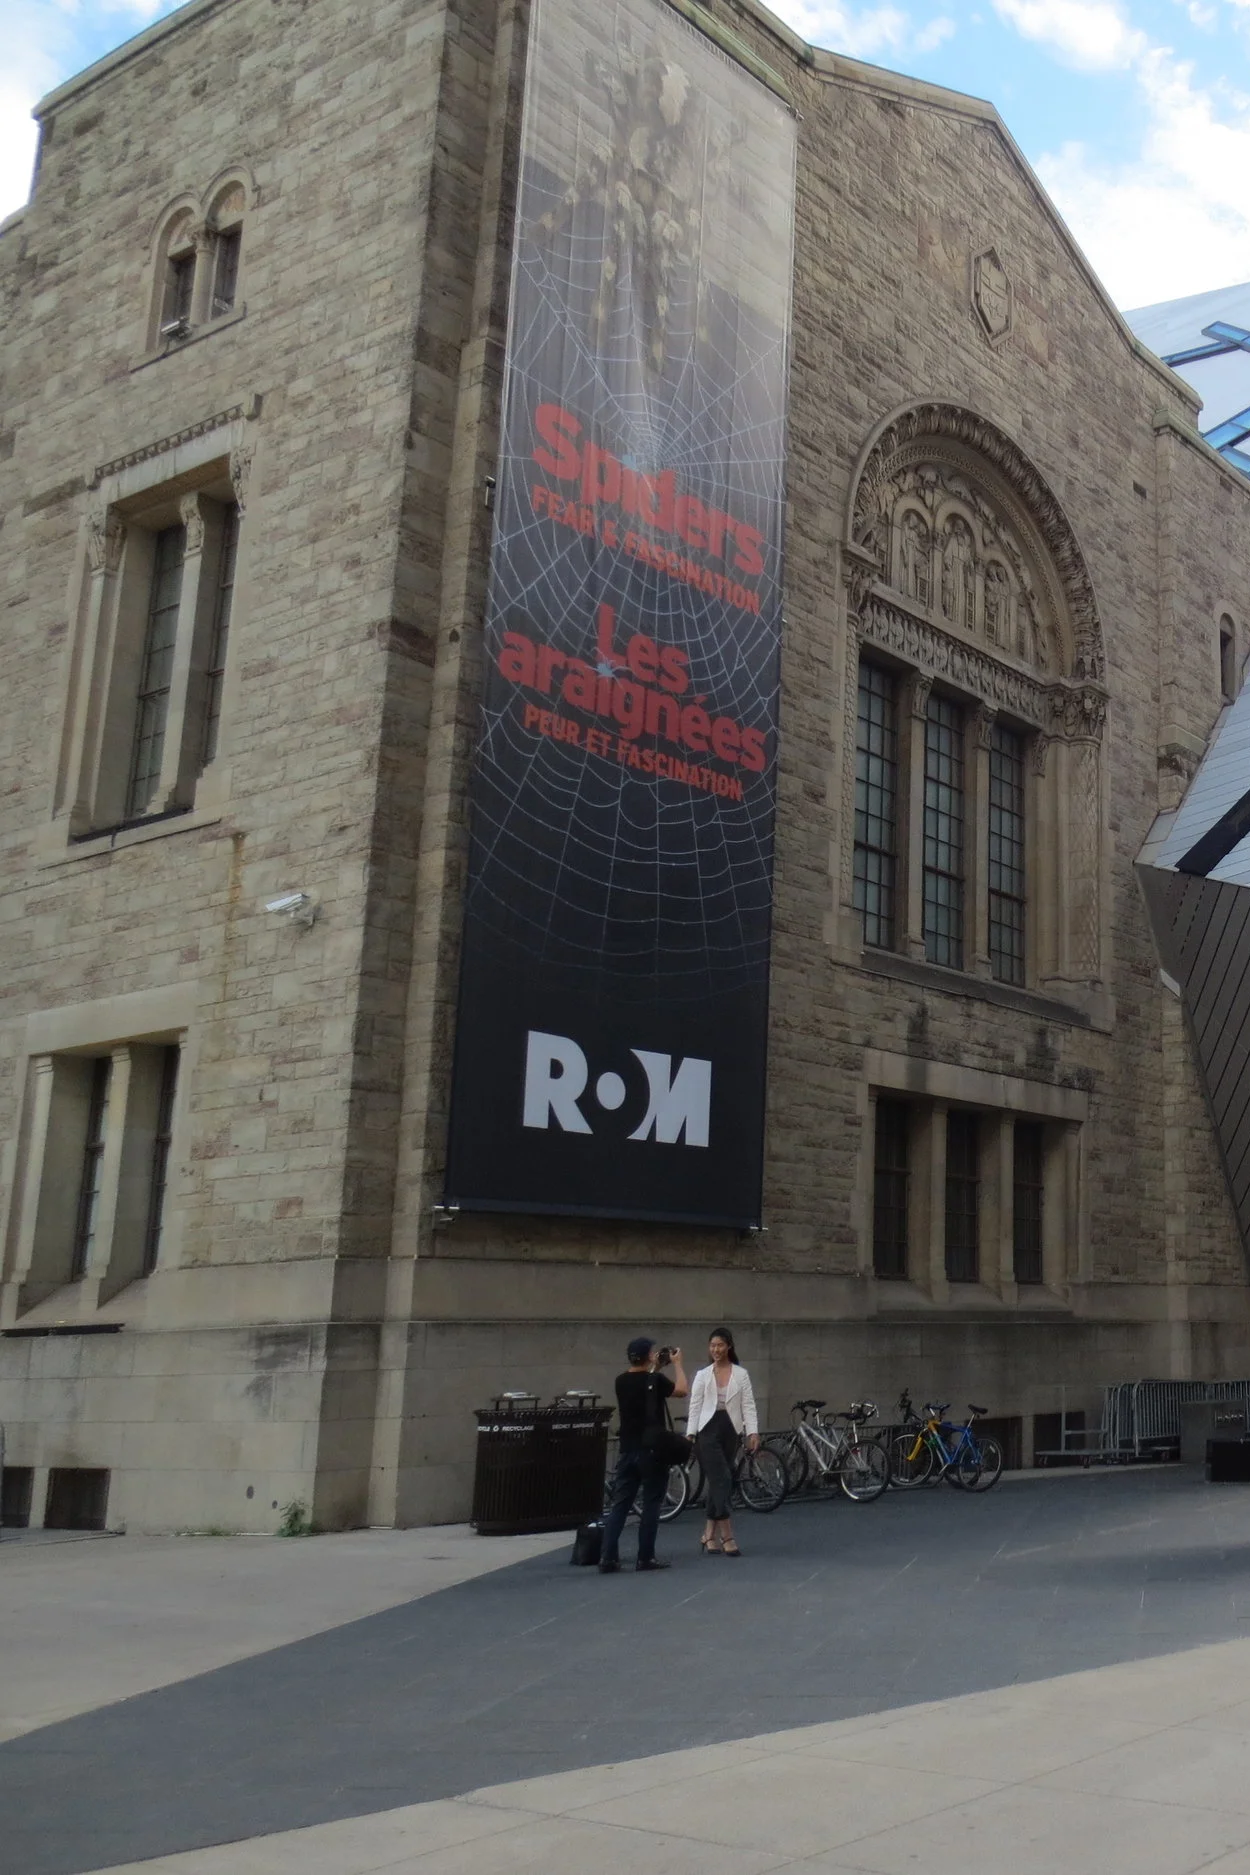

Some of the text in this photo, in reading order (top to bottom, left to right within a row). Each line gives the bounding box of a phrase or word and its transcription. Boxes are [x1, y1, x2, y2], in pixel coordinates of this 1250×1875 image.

[531, 484, 596, 539] FEAR
[624, 531, 761, 616] FASCINATION
[533, 403, 765, 576] Spiders
[497, 631, 767, 773] araignées
[597, 603, 689, 694] Les
[524, 704, 745, 802] PEUR ET FASCINATION
[523, 1030, 712, 1148] ROM
